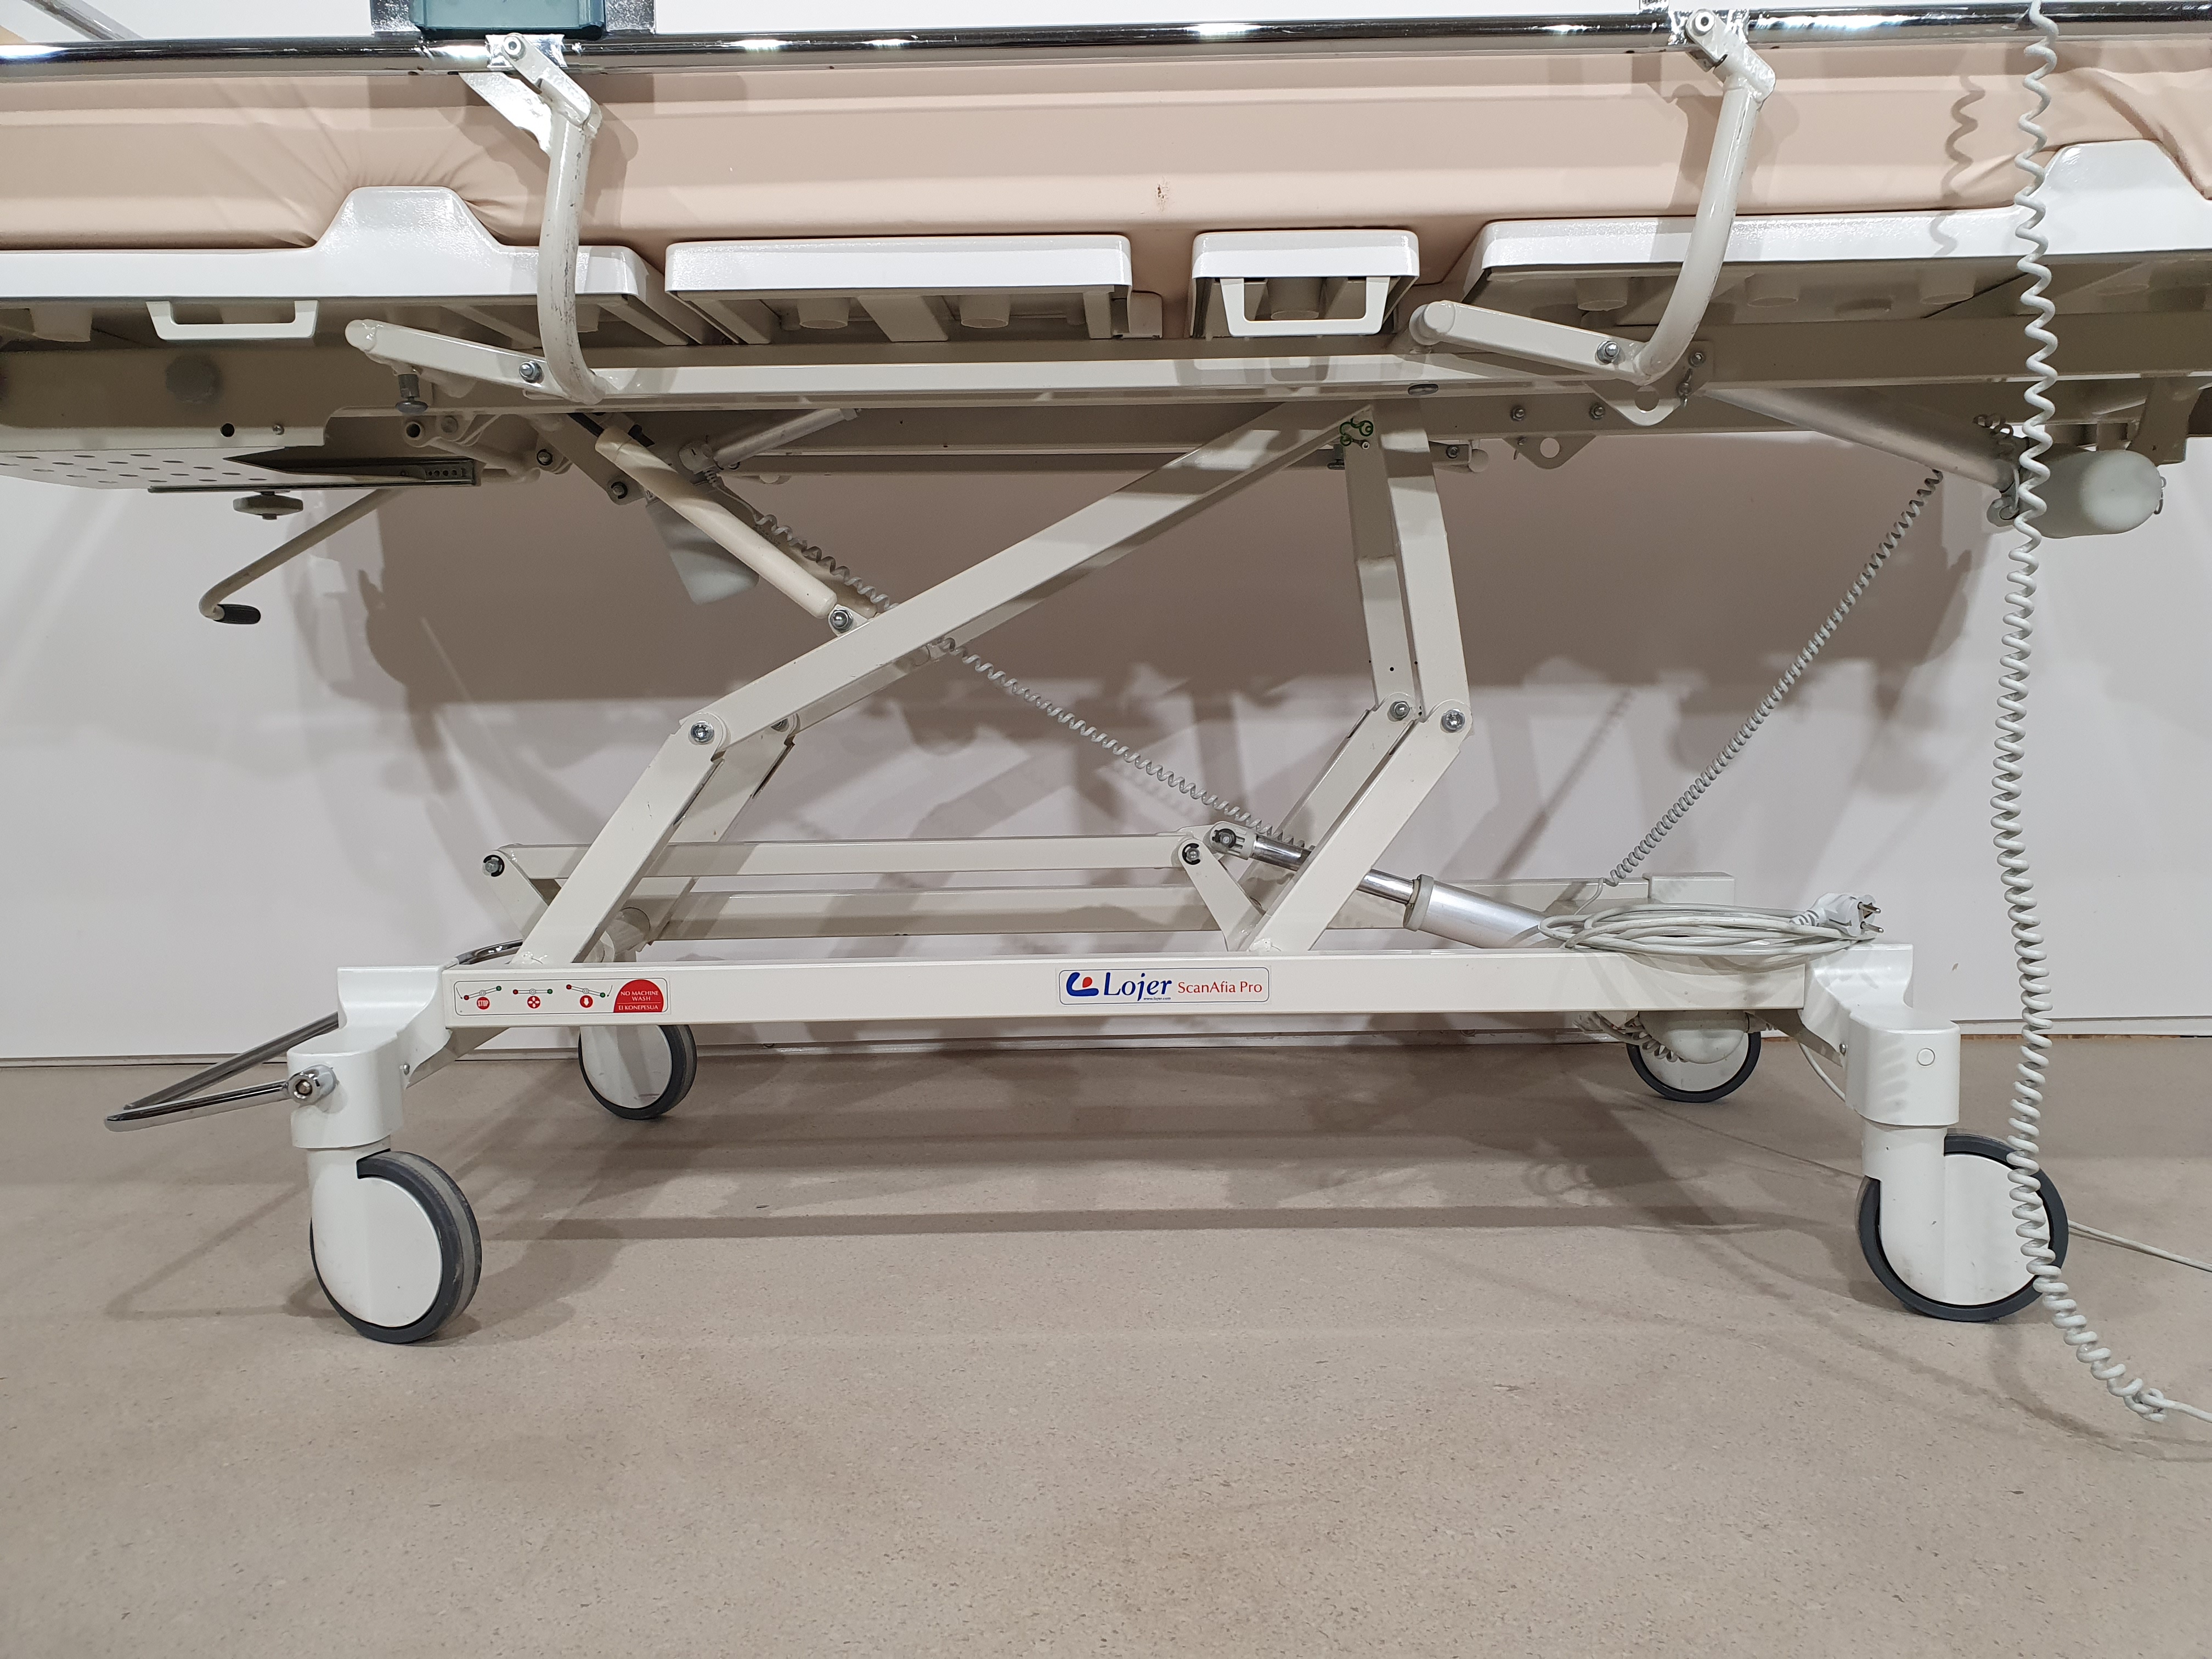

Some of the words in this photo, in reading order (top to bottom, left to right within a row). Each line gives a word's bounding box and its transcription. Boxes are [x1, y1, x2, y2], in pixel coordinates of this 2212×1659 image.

[1104, 972, 1172, 1001] Lojer
[1178, 980, 1236, 994] ScanAfia
[1240, 980, 1262, 993] Pro
